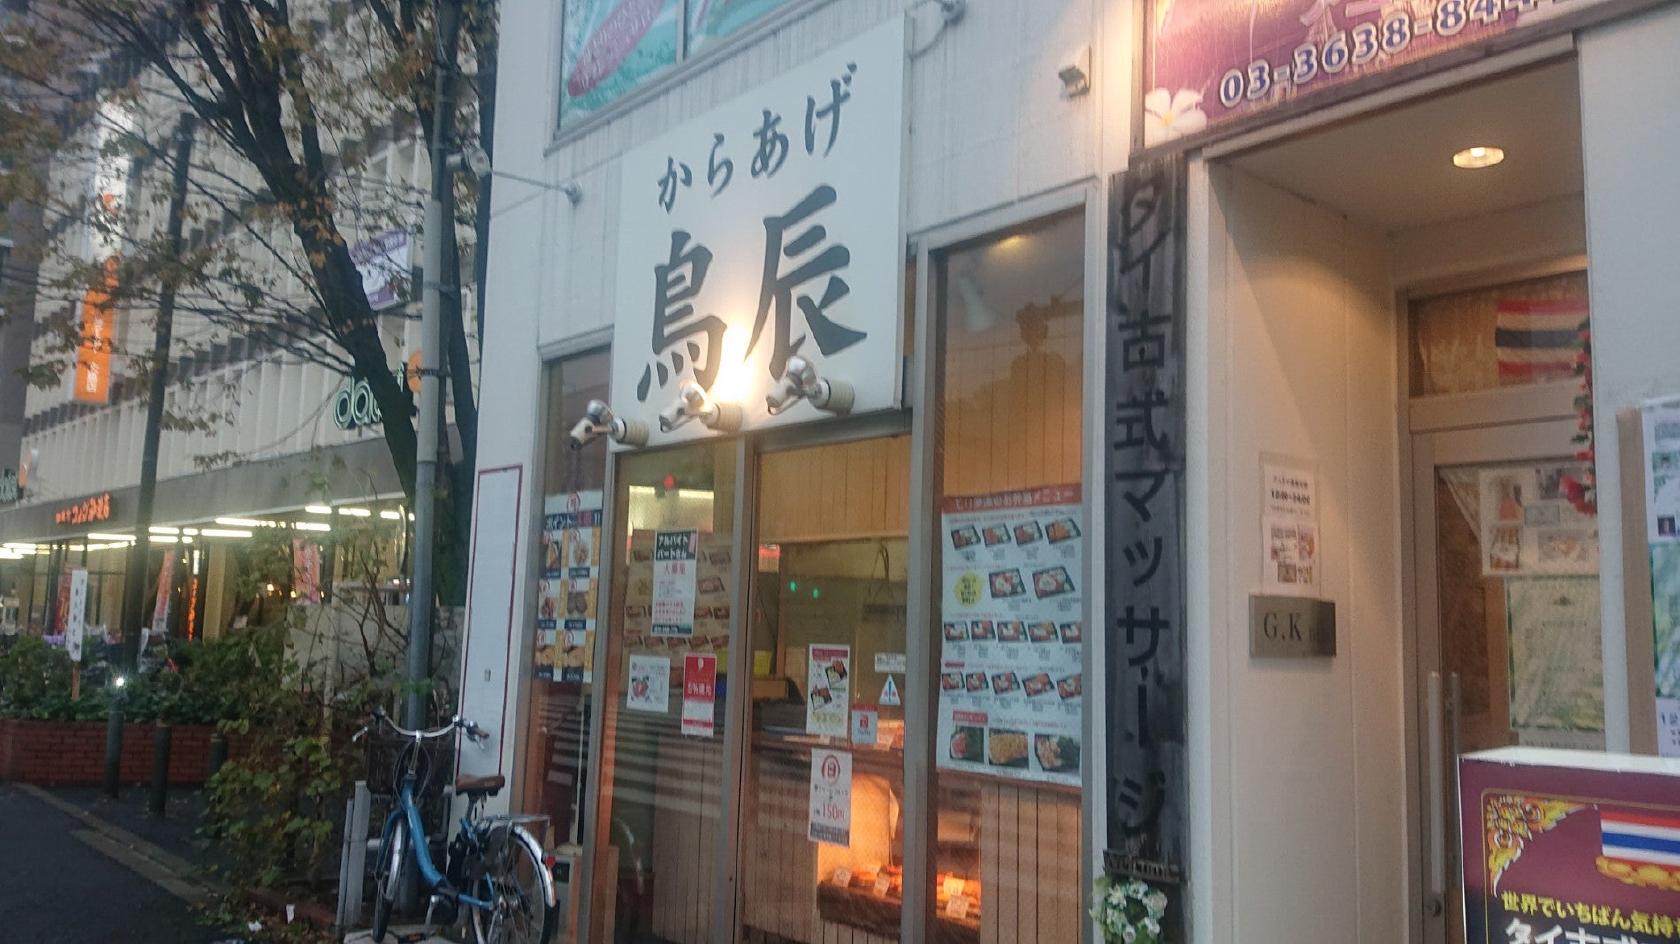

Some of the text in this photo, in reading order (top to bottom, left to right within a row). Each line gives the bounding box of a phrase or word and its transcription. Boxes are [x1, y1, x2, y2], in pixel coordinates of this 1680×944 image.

[1219, 0, 1556, 108] 03-3638-84
[657, 62, 859, 214] からあげ
[636, 184, 868, 403] 鳥辰
[1113, 175, 1175, 838] タイ古式マッサージ
[1501, 889, 1680, 939] 世界でいちばん気持
[1505, 917, 1638, 944] タイ
